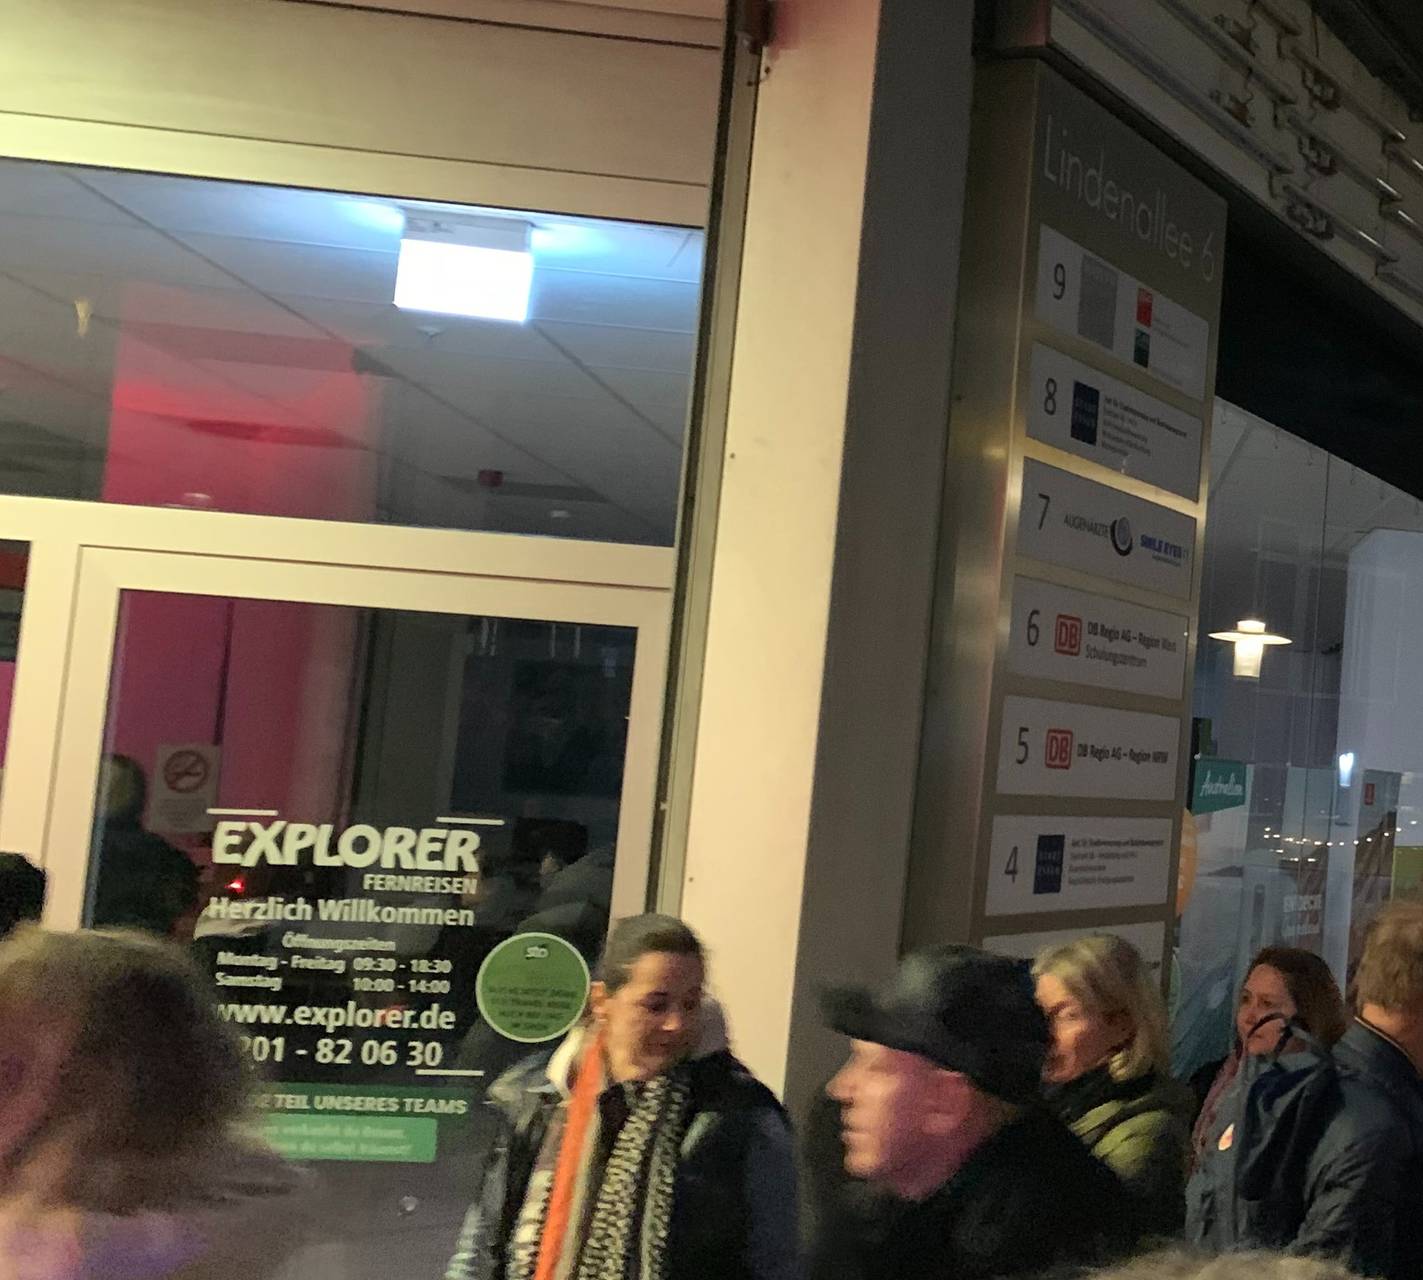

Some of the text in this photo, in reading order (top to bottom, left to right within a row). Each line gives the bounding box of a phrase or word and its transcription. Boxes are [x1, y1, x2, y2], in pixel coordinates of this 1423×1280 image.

[1043, 114, 1215, 282] Lindenallee 6
[1053, 262, 1066, 301] 9
[1044, 377, 1058, 416] 8
[1037, 492, 1051, 531] 7
[1026, 609, 1041, 647] 6
[1057, 619, 1080, 651] DB
[1015, 726, 1030, 765] 5
[1049, 735, 1071, 763] DB
[212, 820, 481, 873] EXPLORER
[1004, 845, 1018, 883] 4
[363, 873, 478, 895] FERNREISEN
[208, 896, 475, 927] Herzlich Willkommen
[216, 951, 279, 971] Montag
[291, 955, 346, 974] Freitag
[353, 957, 397, 972] 09:30
[410, 959, 452, 974] 18:30
[216, 972, 283, 992] Samstag
[353, 977, 396, 992] 10:00
[409, 979, 450, 994] 14:00
[217, 1000, 457, 1033] www.explorer.de
[315, 1038, 353, 1064] 82
[361, 1039, 398, 1066] 06
[406, 1040, 444, 1067] 30
[273, 1094, 311, 1110] TEIL
[314, 1095, 401, 1113] UNSERES
[403, 1097, 468, 1115] TEAMS
